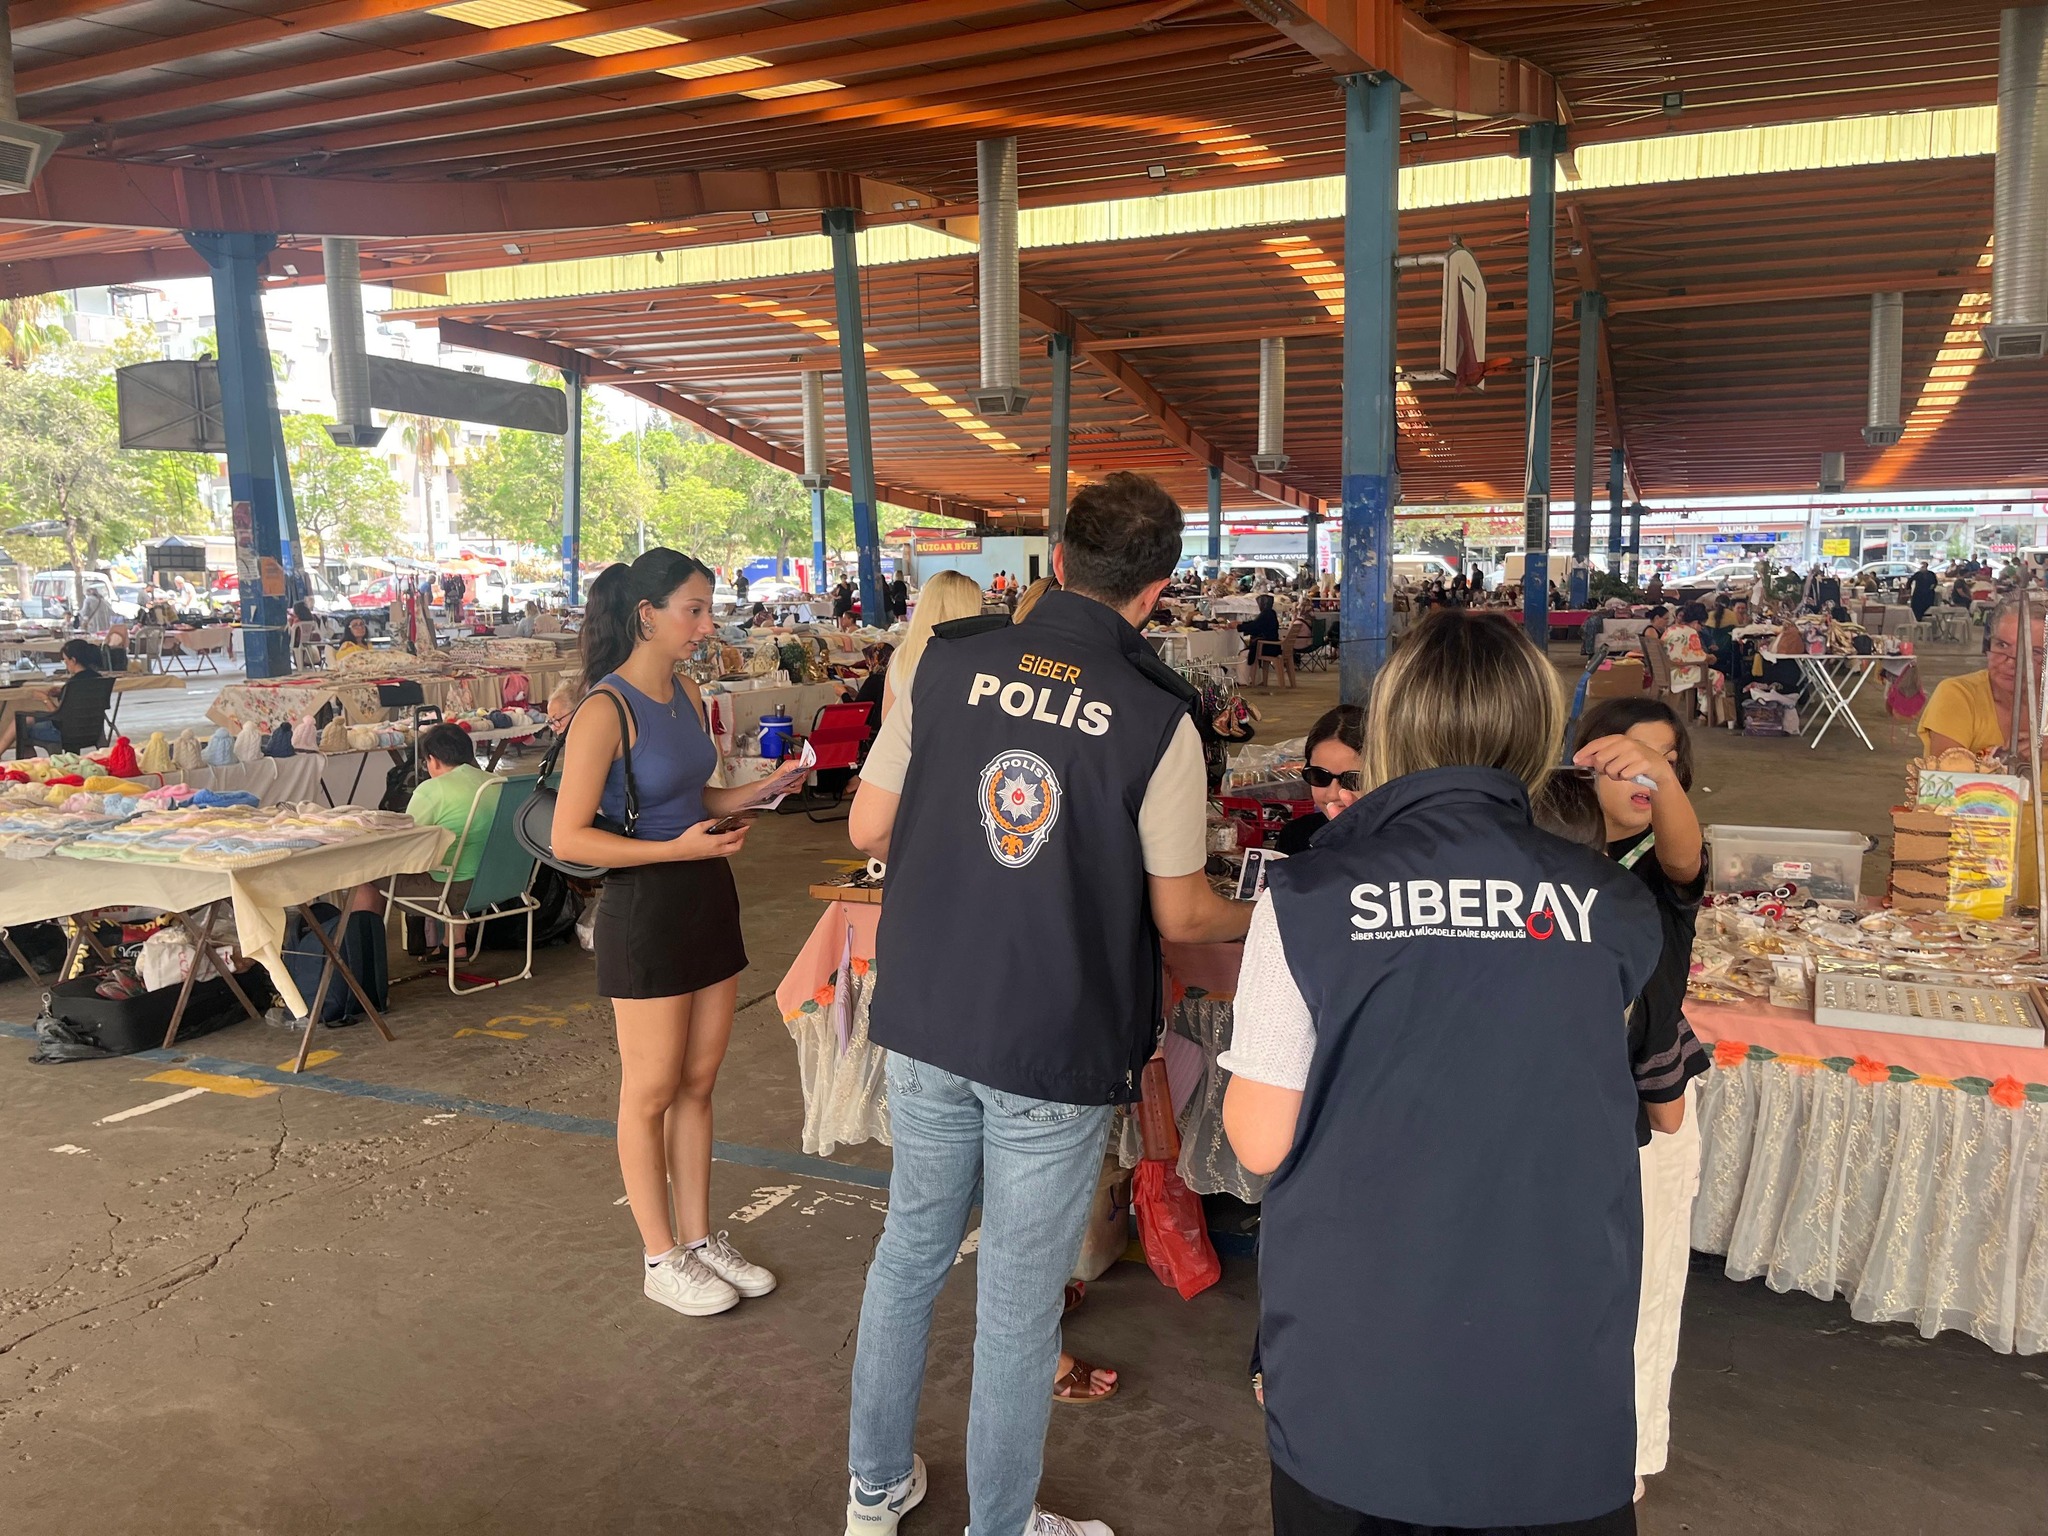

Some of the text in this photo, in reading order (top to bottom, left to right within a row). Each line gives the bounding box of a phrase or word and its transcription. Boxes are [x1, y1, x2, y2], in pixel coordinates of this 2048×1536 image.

[916, 541, 979, 552] RÜZGAR BÜFE
[1018, 653, 1082, 685] SİBER
[967, 673, 1113, 736] POLİS
[1001, 758, 1045, 779] POLİS
[1350, 879, 1599, 943] SİBERAY
[1350, 926, 1527, 941] SİBER SUÇLARLA MÜCADELE DAİRE BAŞKANLIĞI
